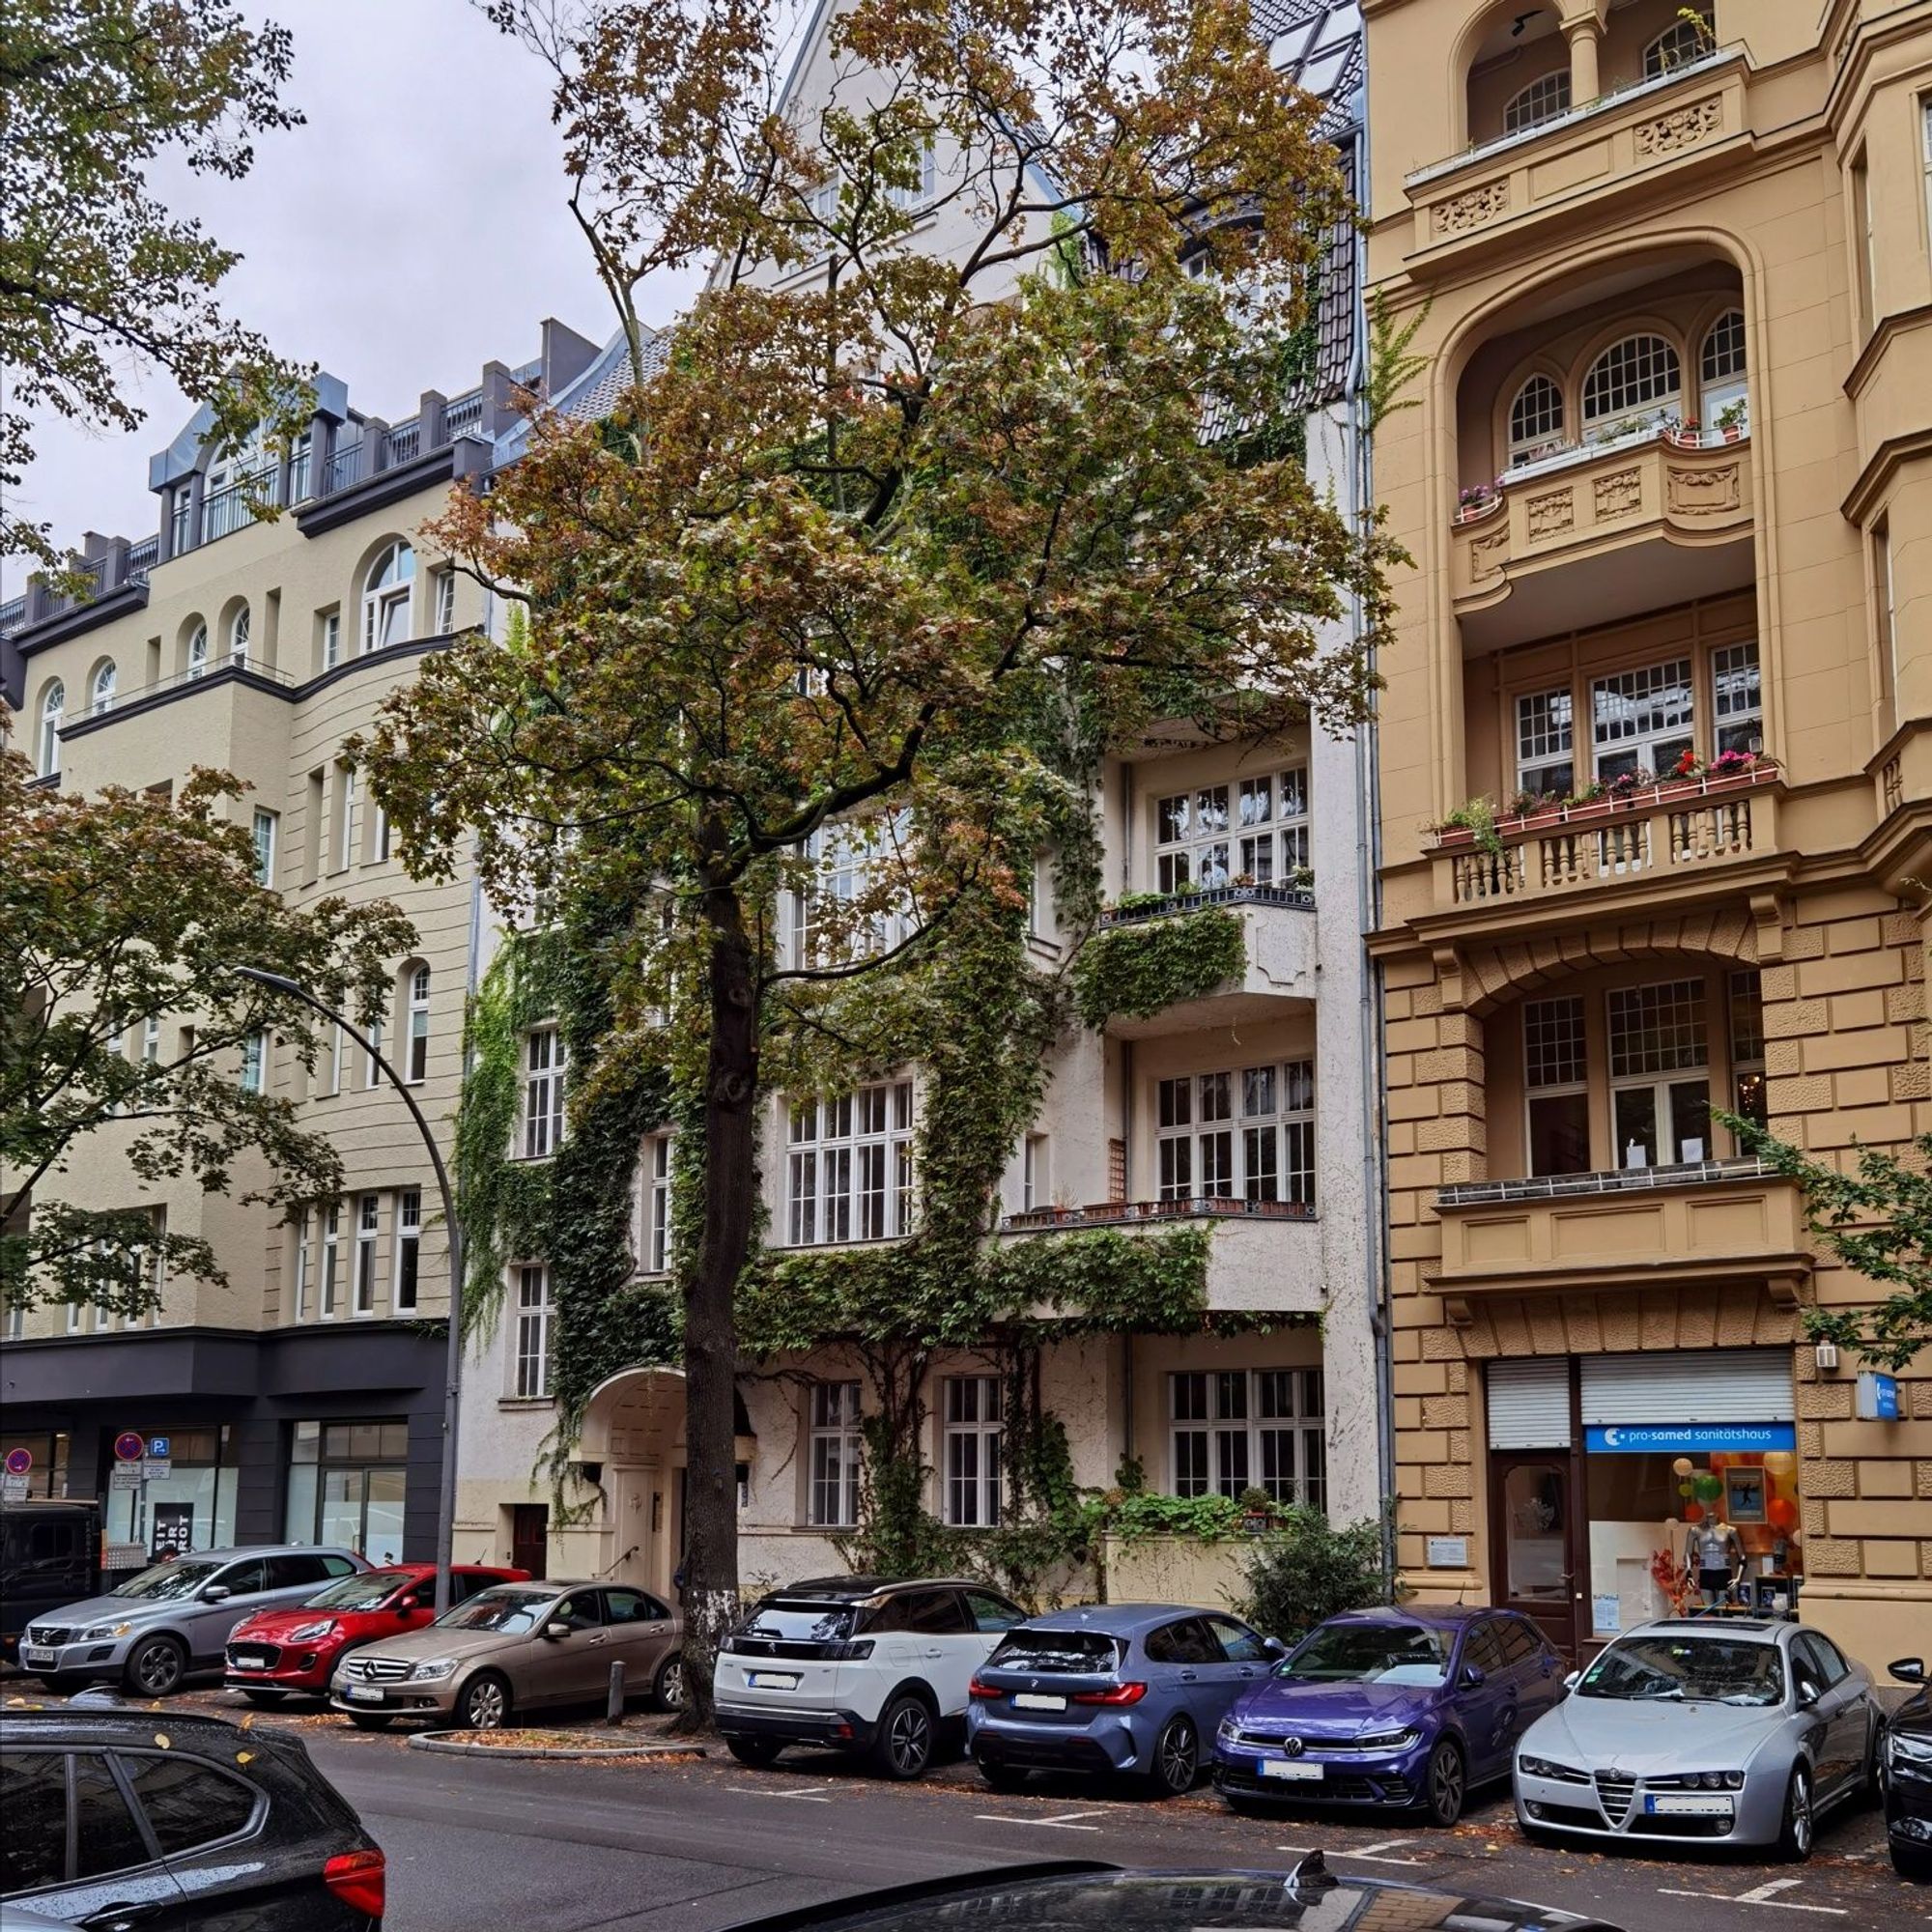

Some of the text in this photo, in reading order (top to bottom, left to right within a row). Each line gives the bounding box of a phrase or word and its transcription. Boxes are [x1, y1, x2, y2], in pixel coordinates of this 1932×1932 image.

[154, 1440, 163, 1453] P
[1629, 1427, 1773, 1443] pro-samed sanitätshaus
[156, 1520, 166, 1550] EIT
[178, 1515, 189, 1551] ROT
